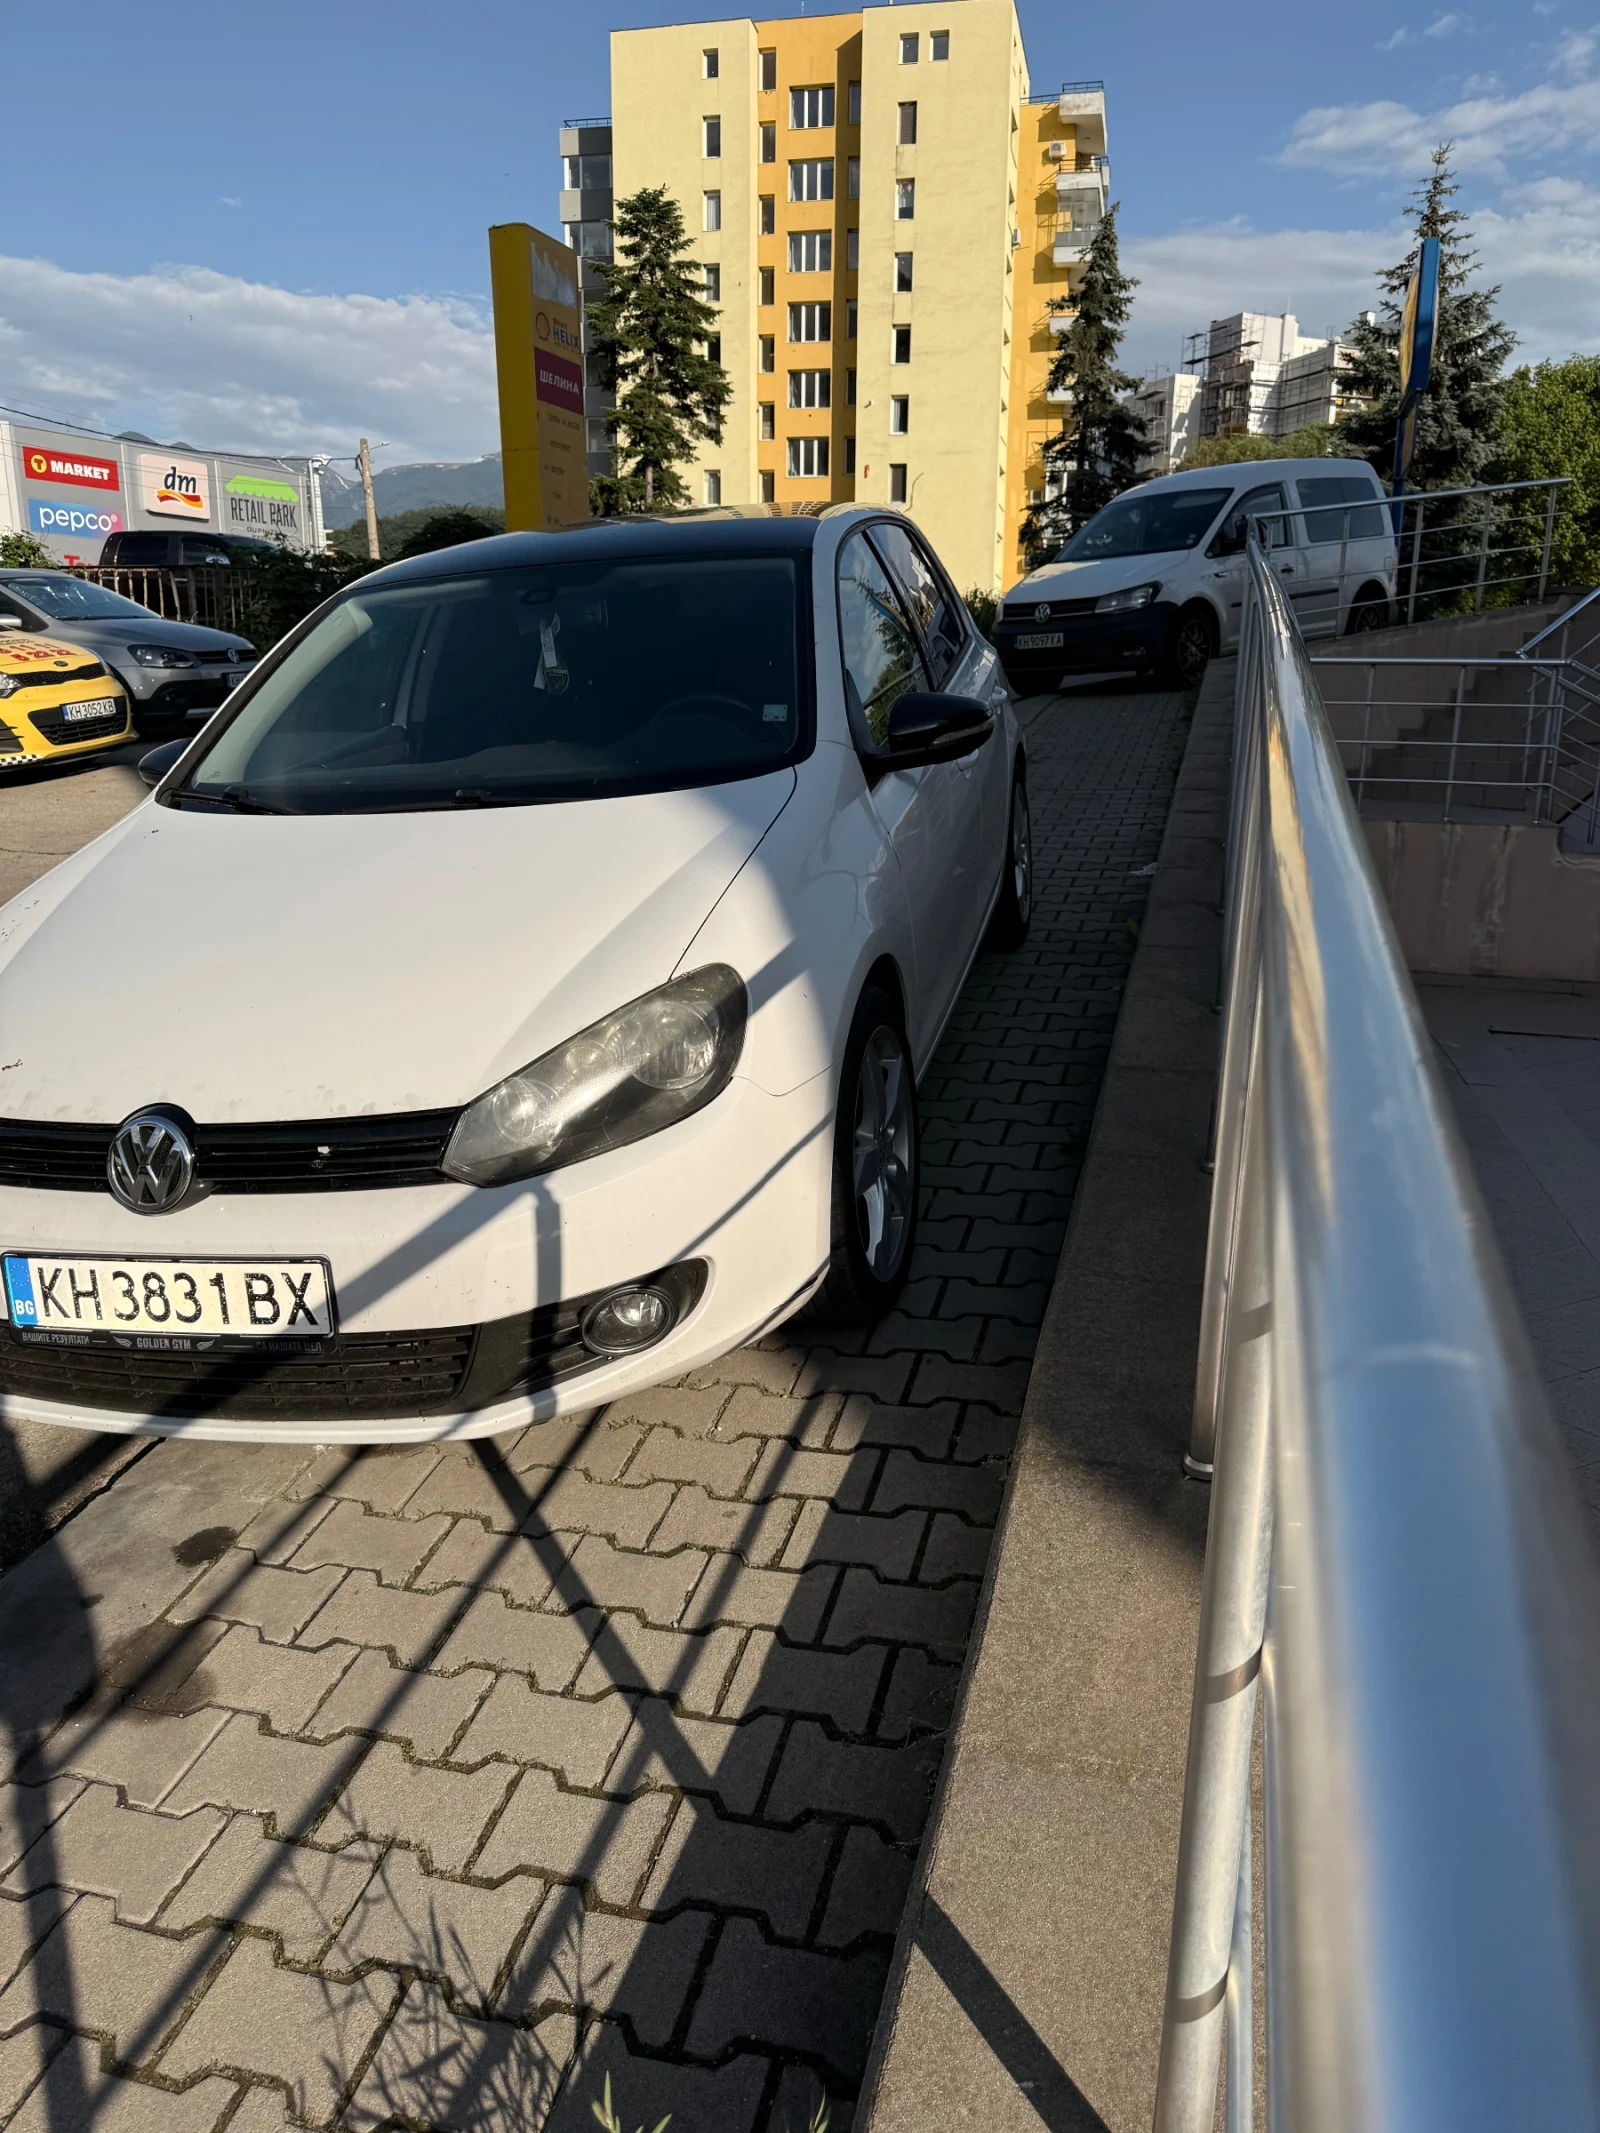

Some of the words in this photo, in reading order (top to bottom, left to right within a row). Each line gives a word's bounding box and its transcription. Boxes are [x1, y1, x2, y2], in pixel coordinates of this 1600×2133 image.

[552, 326, 580, 350] HELIX
[539, 368, 580, 395] ШЕЛИНА
[50, 460, 110, 481] MARKET
[164, 466, 197, 494] dm
[39, 506, 112, 532] pepco
[230, 497, 267, 524] RETAIL
[269, 503, 297, 528] PARK
[15, 1300, 35, 1316] BG
[22, 1331, 51, 1345] ВАШИТЕ
[51, 1333, 90, 1346] РЕЗУЛТАТИ
[136, 1337, 171, 1350] GOLDEN
[172, 1338, 192, 1351] GYM
[256, 1341, 268, 1352] СА
[269, 1341, 302, 1352] НАШАТА
[304, 1341, 322, 1353] ЦЕЛ
